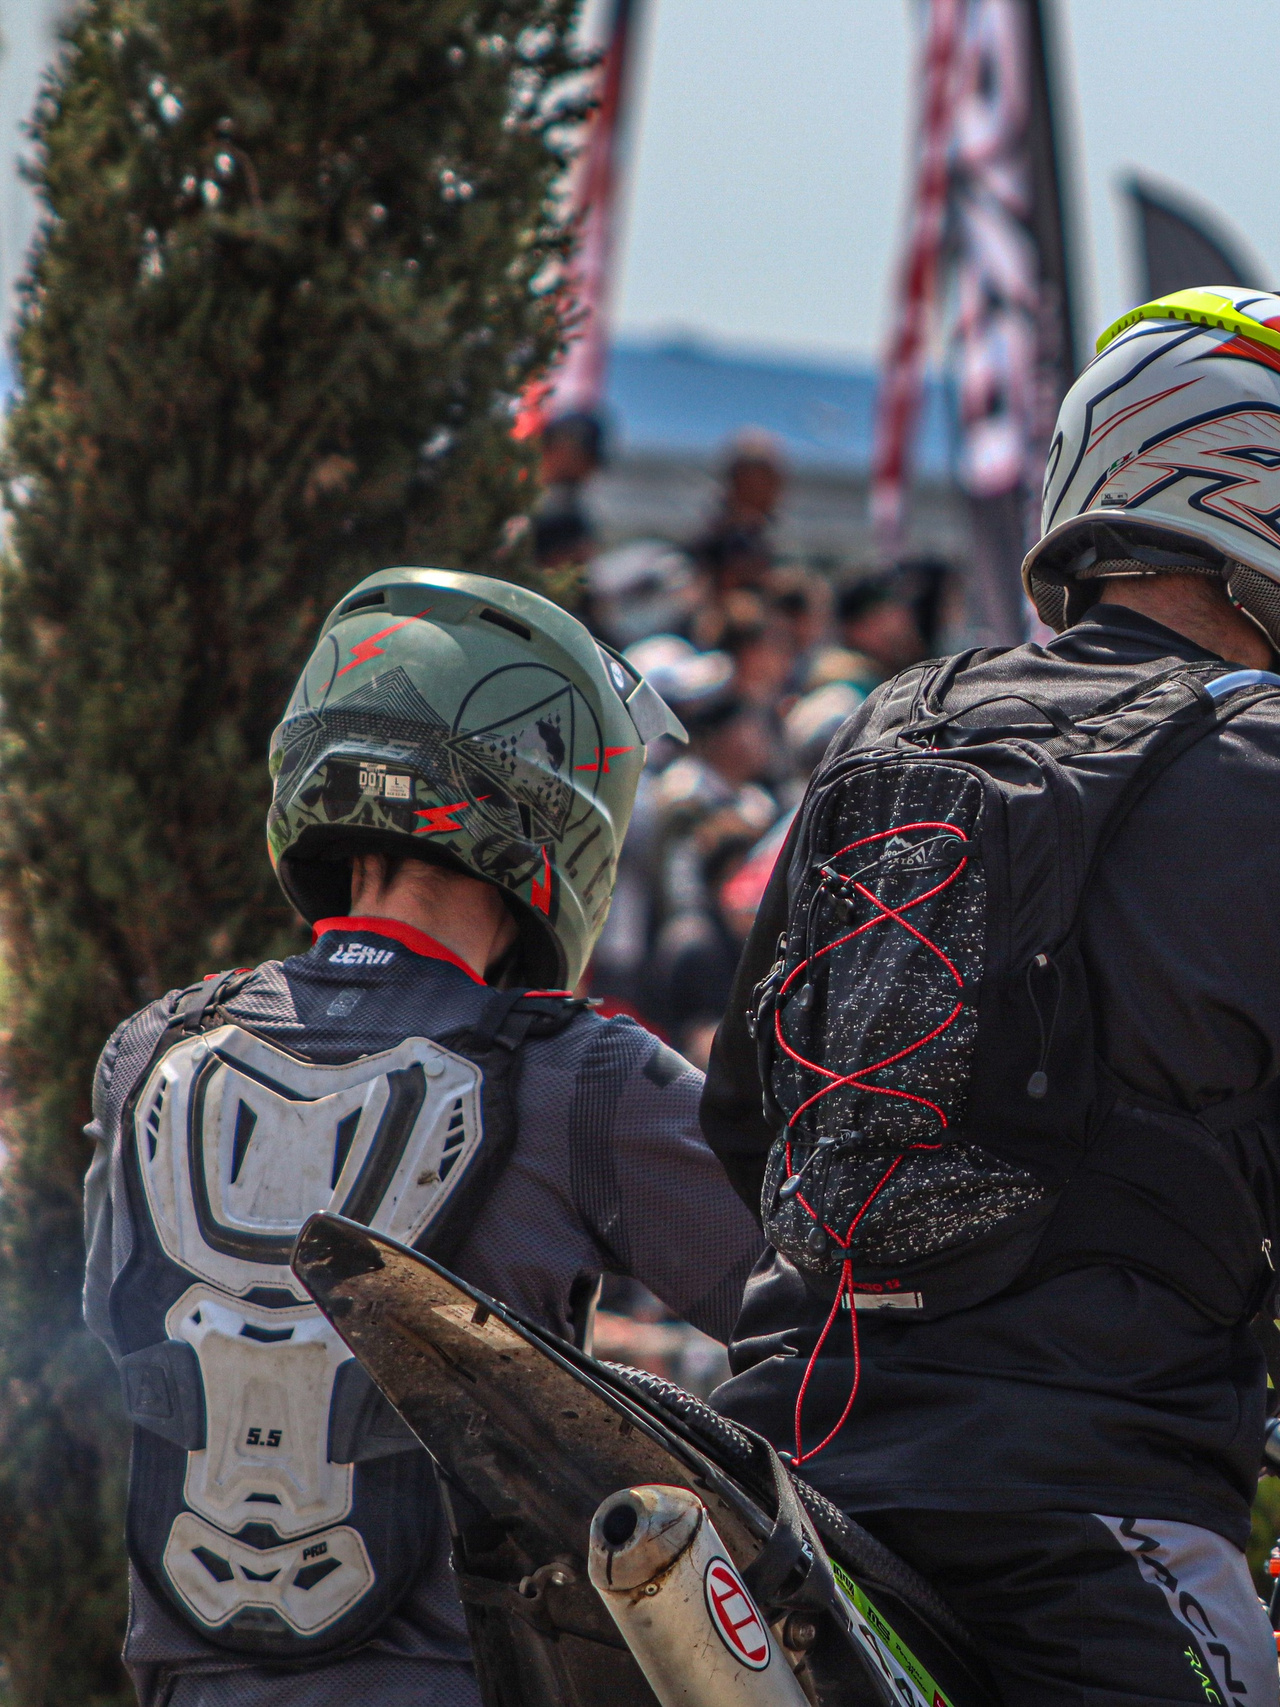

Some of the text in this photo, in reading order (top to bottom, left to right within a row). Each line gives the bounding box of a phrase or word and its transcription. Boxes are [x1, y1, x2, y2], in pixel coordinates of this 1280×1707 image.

[359, 770, 386, 788] DOT
[394, 776, 400, 786] L
[246, 1427, 283, 1447] 5.5
[302, 1541, 328, 1561] PRO
[1119, 1517, 1247, 1707] MACN
